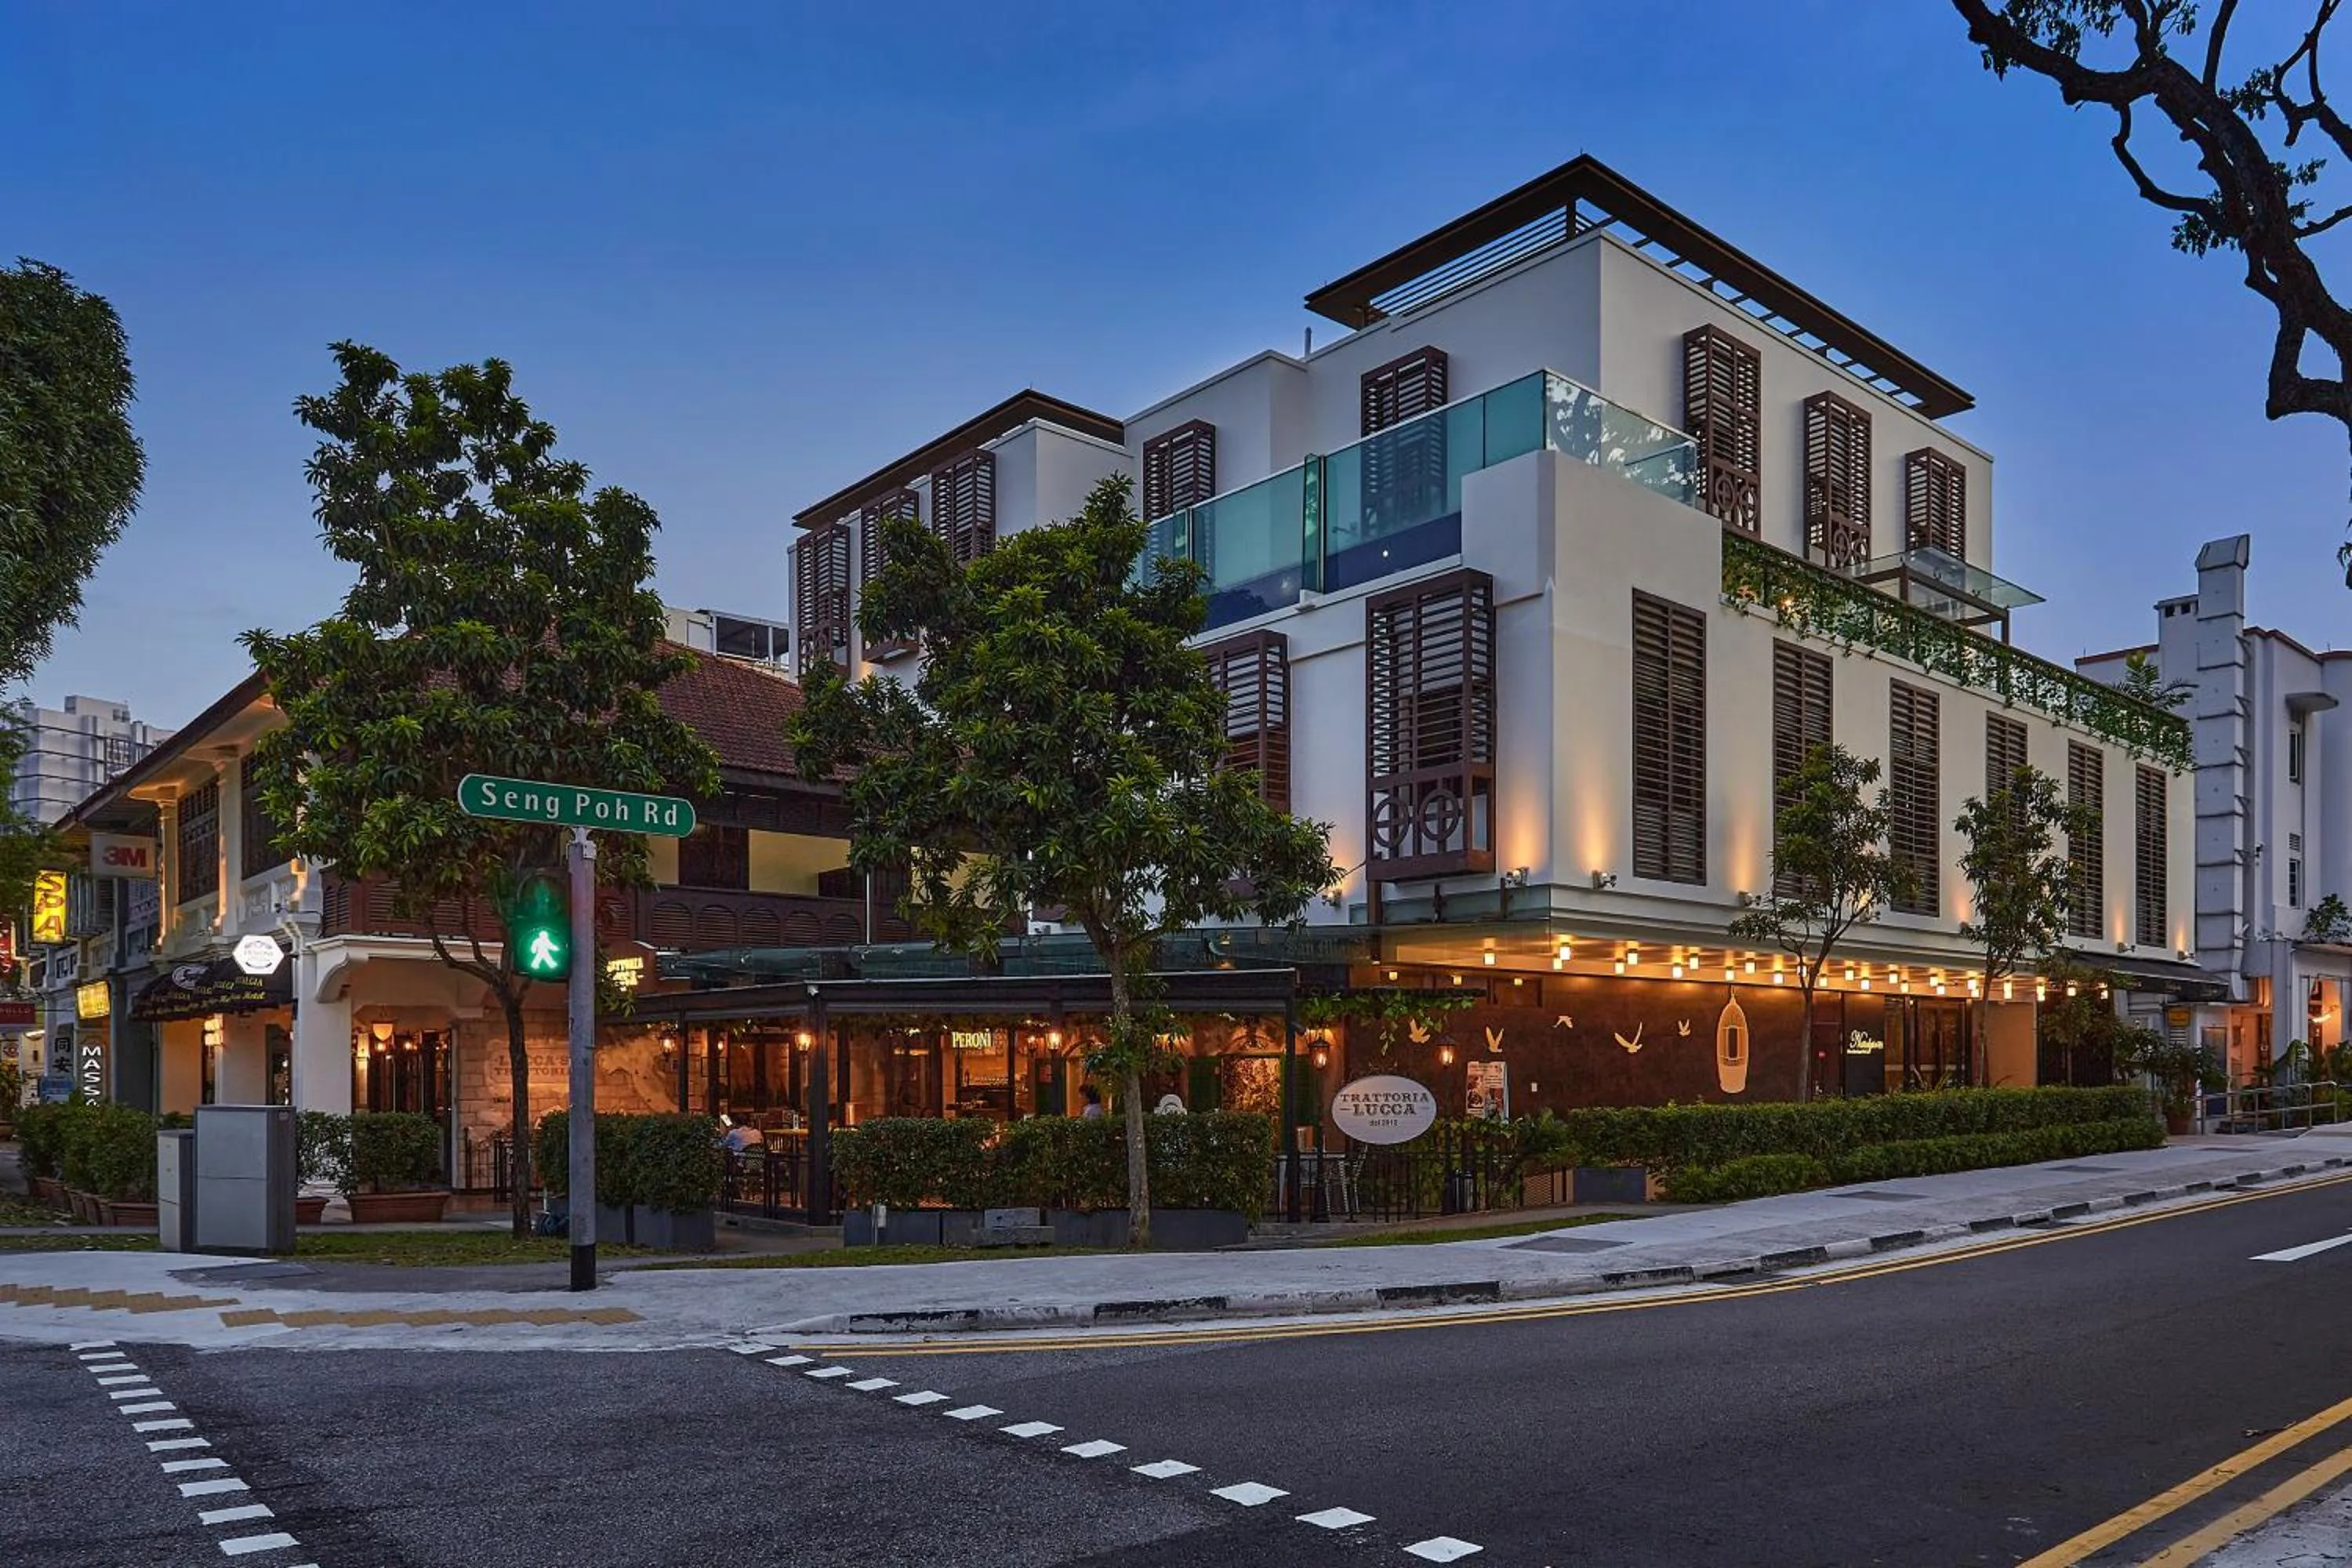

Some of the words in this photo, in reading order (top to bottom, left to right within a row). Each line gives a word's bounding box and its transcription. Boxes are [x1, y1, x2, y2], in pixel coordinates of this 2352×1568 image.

[481, 782, 560, 819] Seng
[575, 790, 629, 821] Poh
[644, 801, 677, 826] Rd
[103, 845, 147, 868] 3M
[35, 872, 65, 935] SPA
[952, 1028, 992, 1049] PERONI
[1341, 1092, 1428, 1104] TRATTORIA
[1353, 1103, 1417, 1116] LUCCA
